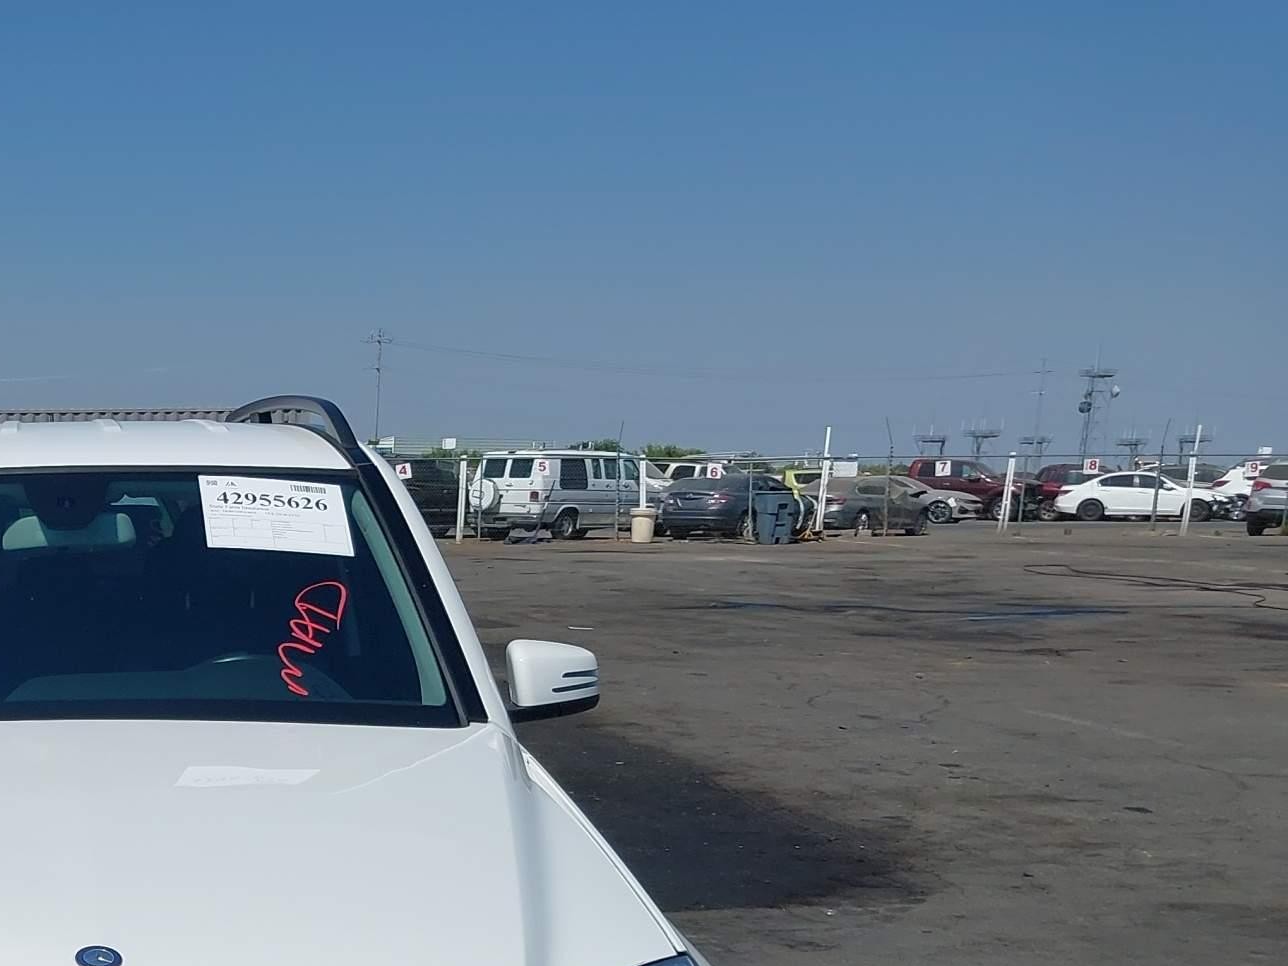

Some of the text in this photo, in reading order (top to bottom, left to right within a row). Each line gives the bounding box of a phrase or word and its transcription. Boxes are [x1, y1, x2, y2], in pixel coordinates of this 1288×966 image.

[399, 465, 408, 475] 4
[538, 461, 546, 472] 5
[939, 462, 947, 473] 7
[1088, 460, 1097, 471] 8
[1250, 462, 1258, 473] 9
[711, 467, 718, 478] 6
[217, 491, 328, 512] 42955626
